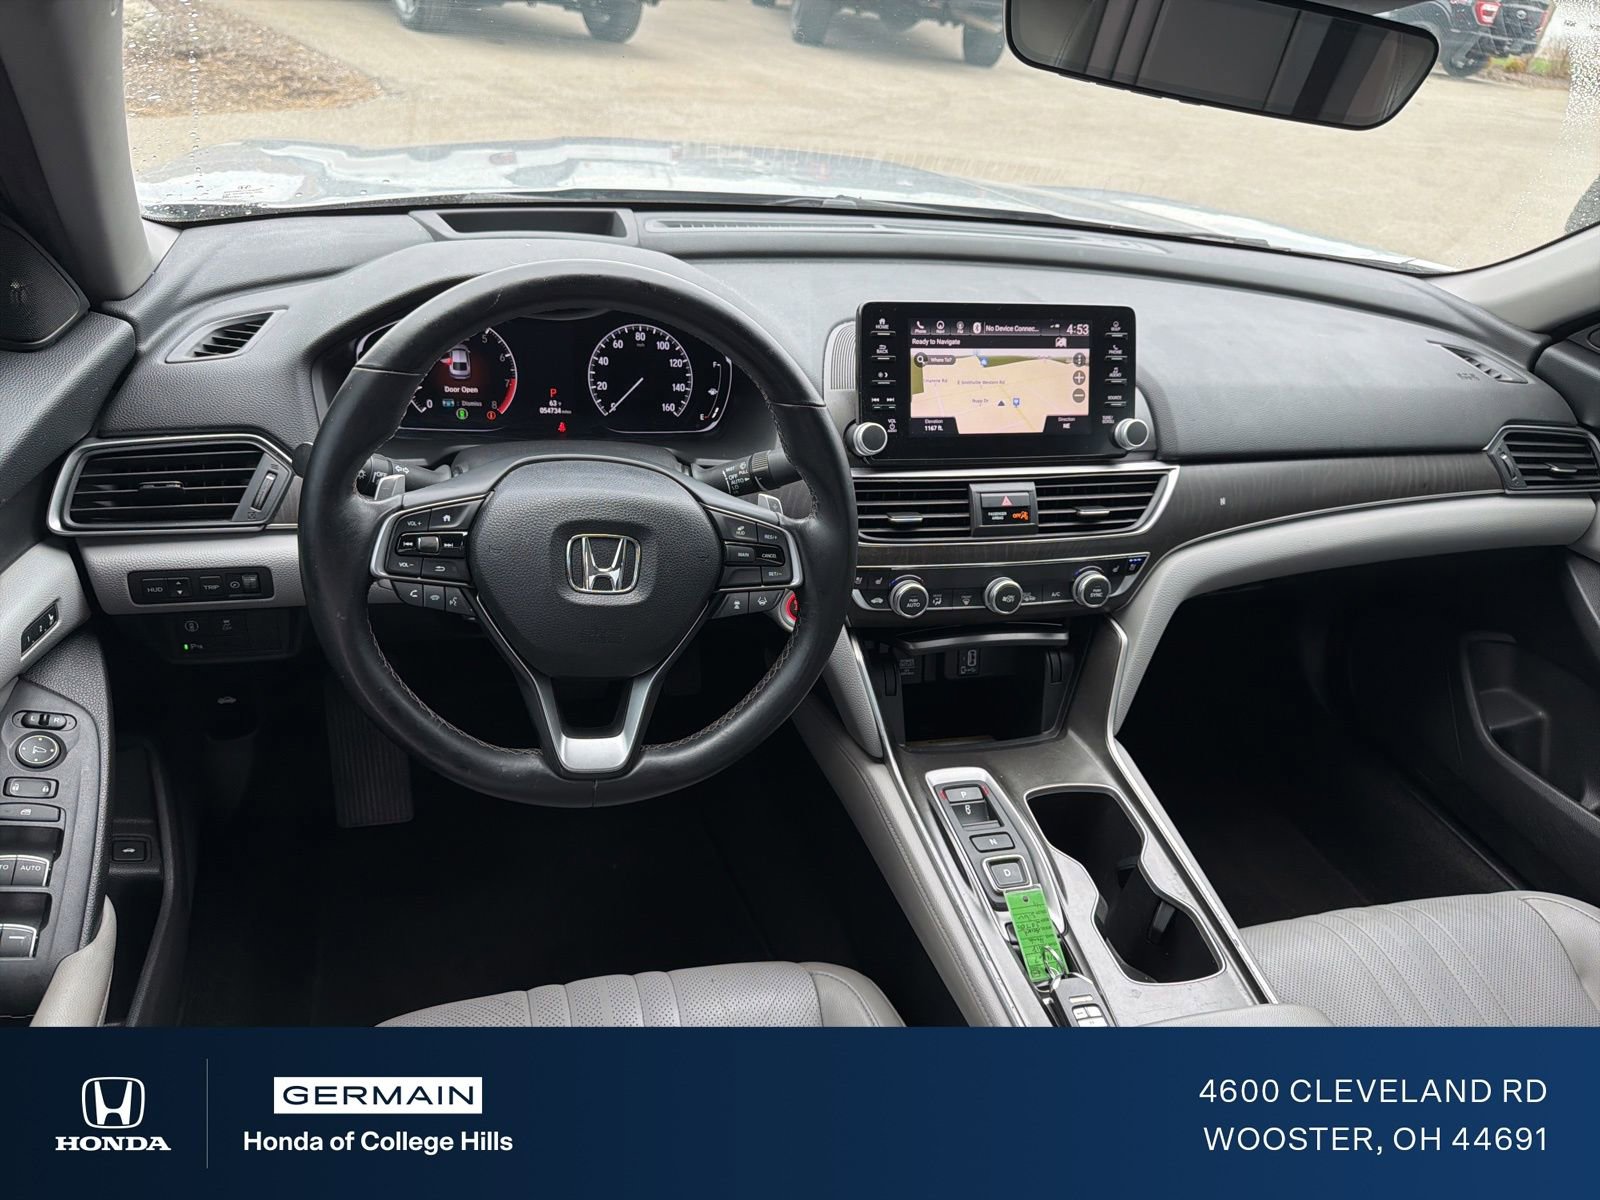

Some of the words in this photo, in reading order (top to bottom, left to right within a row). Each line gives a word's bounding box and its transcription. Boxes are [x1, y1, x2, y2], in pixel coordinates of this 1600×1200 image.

[1066, 324, 1089, 334] 4:53
[482, 335, 488, 344] 5
[635, 332, 646, 341] 80
[612, 340, 624, 349] 60
[656, 342, 670, 350] 100
[500, 354, 506, 362] 6
[598, 356, 609, 366] 40
[670, 359, 683, 368] 120
[461, 386, 478, 394] Open
[596, 382, 608, 390] 20
[672, 384, 686, 392] 140
[550, 388, 557, 398] P
[426, 400, 433, 408] 0
[492, 400, 498, 410] 8
[662, 403, 676, 412] 160
[1004, 868, 1011, 876] D
